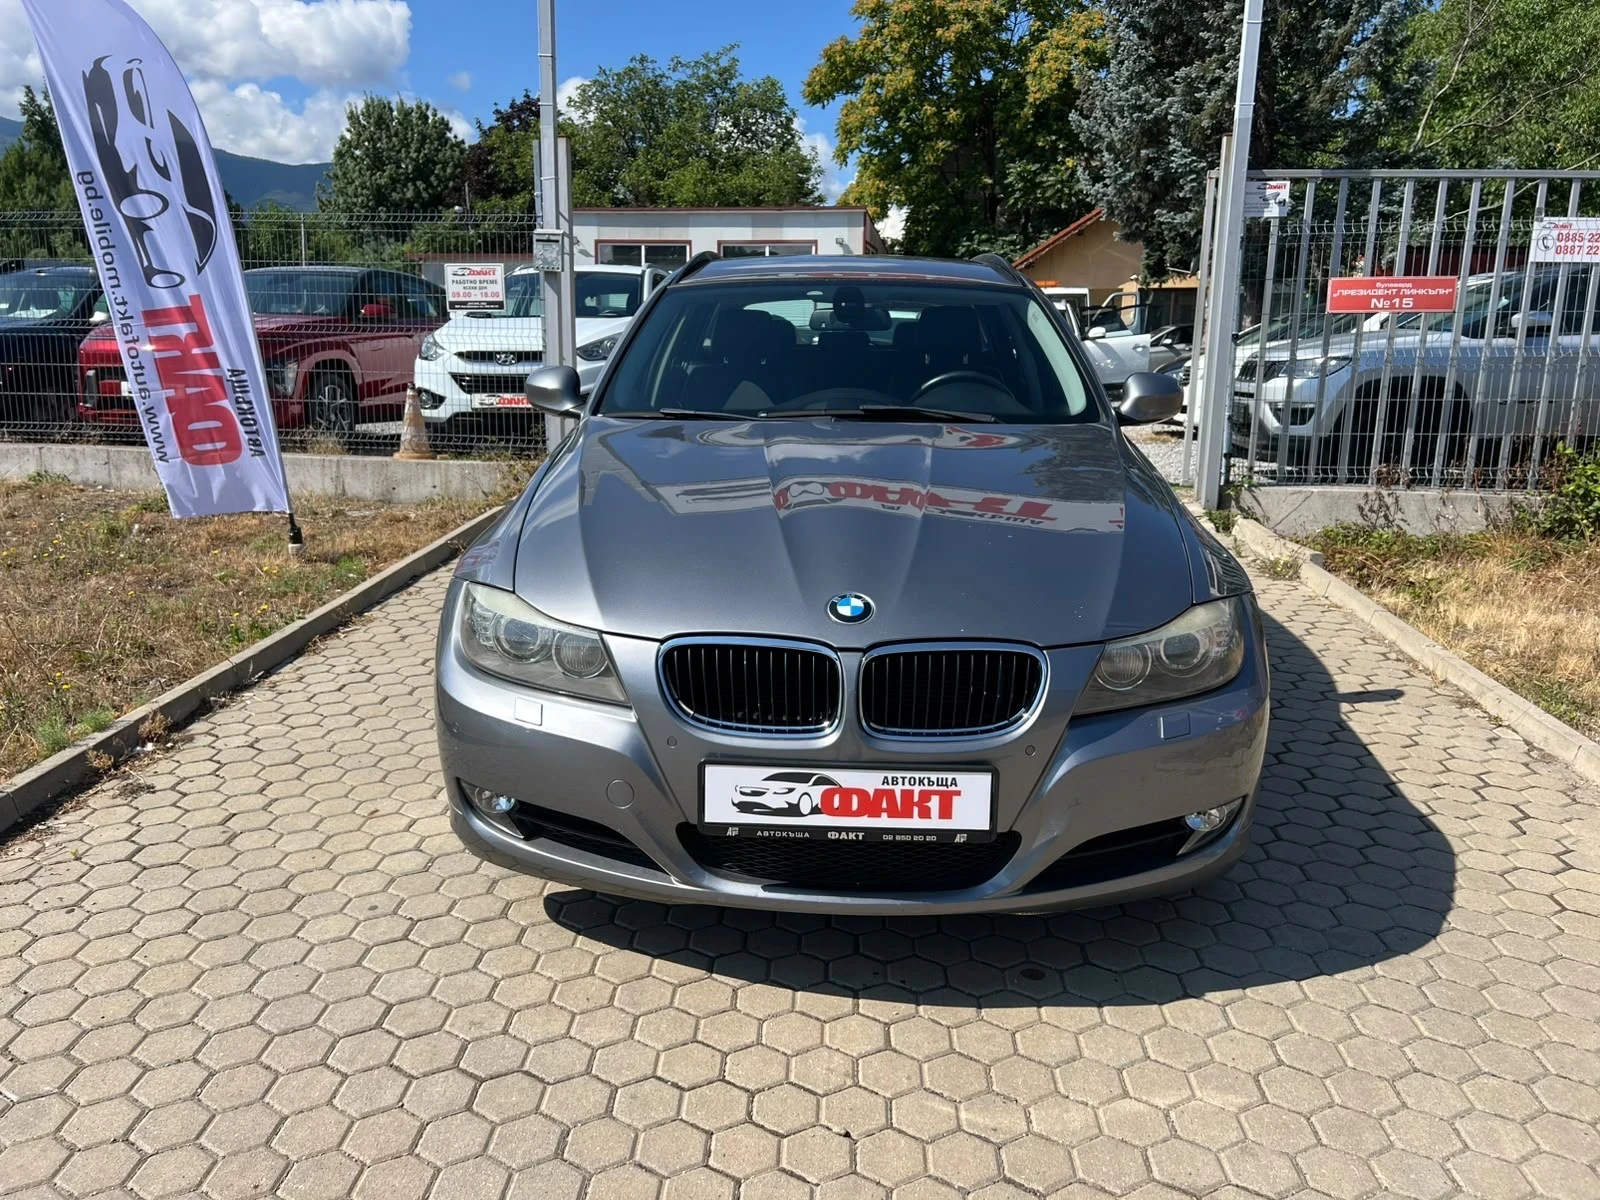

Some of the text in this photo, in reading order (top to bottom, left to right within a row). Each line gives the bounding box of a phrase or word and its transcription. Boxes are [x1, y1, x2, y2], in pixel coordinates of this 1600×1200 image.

[1557, 233, 1584, 242] 0885
[1556, 245, 1600, 255] 0887 22
[881, 775, 958, 788] АВТОКЪЩА
[820, 787, 962, 820] ФАКТ
[756, 830, 810, 838] АВТОКЪЩА
[827, 831, 865, 840] ФАКТ
